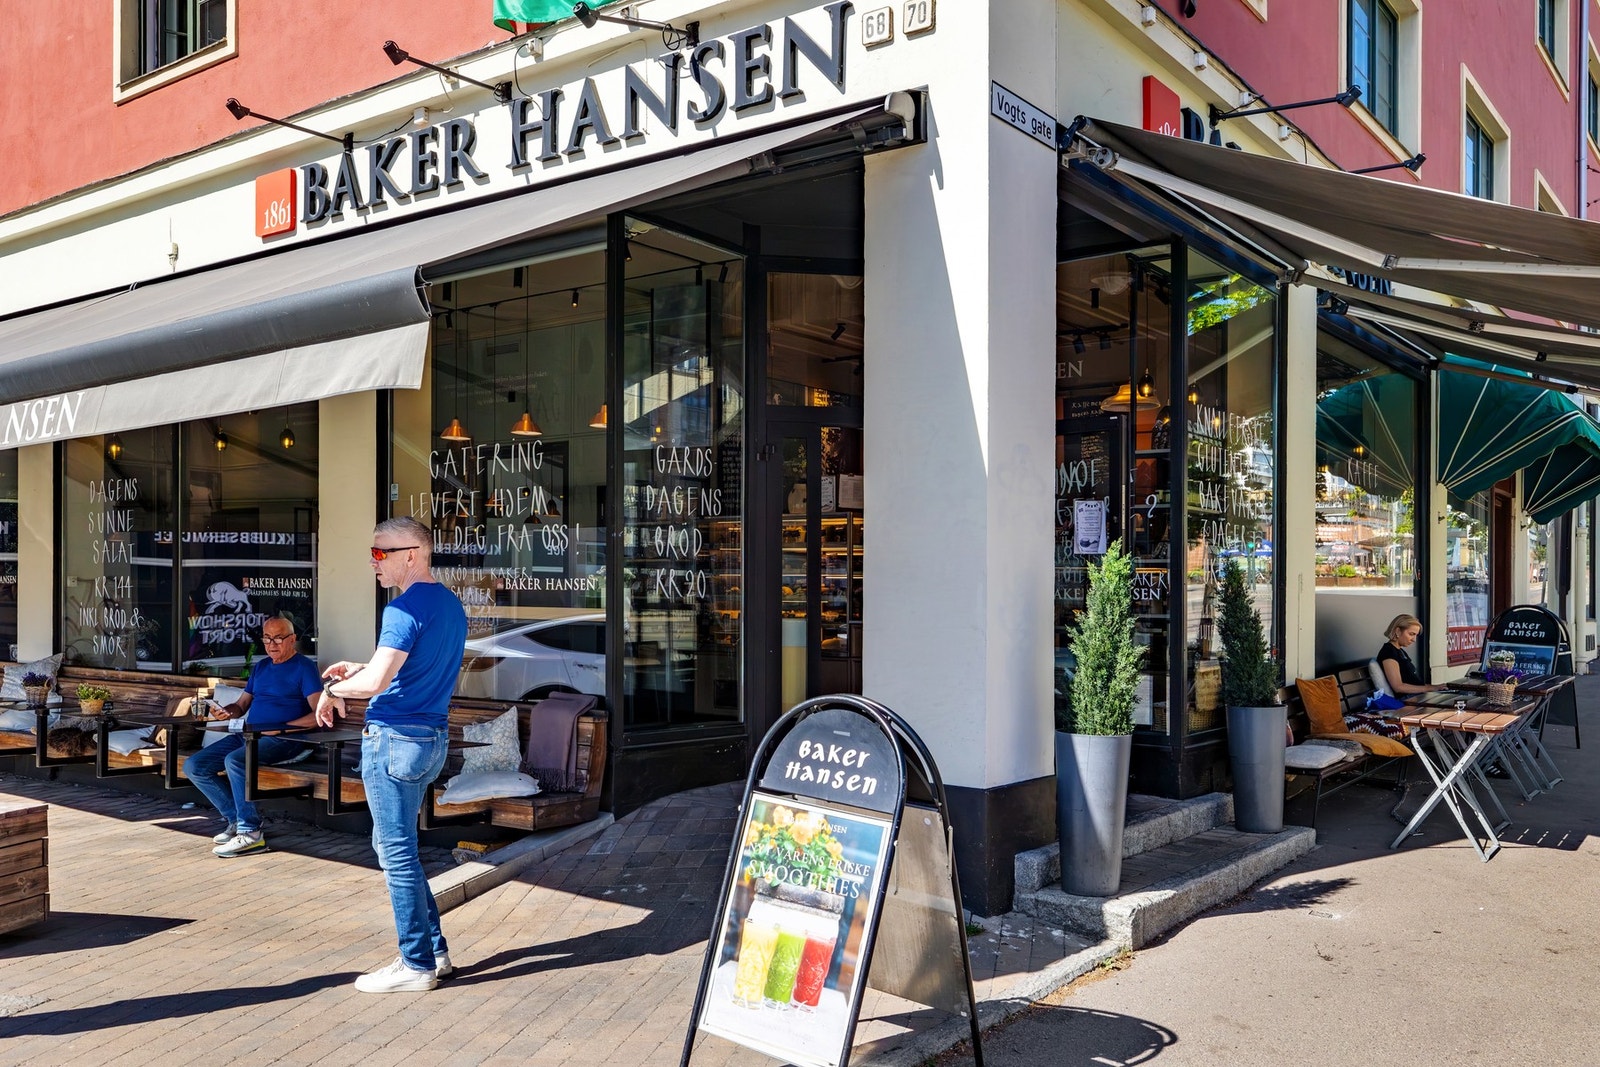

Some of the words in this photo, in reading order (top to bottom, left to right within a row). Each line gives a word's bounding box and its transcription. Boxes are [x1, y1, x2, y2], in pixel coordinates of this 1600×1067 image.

[866, 12, 885, 38] 68
[907, 1, 927, 28] 70
[301, 121, 488, 223] BAKER
[506, 1, 852, 169] HANSEN
[997, 92, 1026, 123] Vogts
[1031, 117, 1052, 140] gate
[264, 199, 291, 229] 1861
[2, 391, 85, 444] NSEN
[89, 478, 137, 504] DAGENS
[410, 489, 480, 518] LEVERT
[494, 486, 548, 518] HJEM
[646, 485, 722, 516] DAGENS
[88, 509, 134, 534] SUNNE
[455, 524, 486, 551] DEG
[497, 523, 532, 552] FRA
[541, 524, 569, 550] OSS
[93, 540, 135, 565] SALAT
[95, 575, 110, 599] KR
[114, 575, 134, 599] 144
[249, 577, 275, 588] BAKER
[277, 578, 312, 589] HANSEN
[505, 577, 541, 590] BAKER
[546, 577, 596, 591] HANSEN
[656, 568, 683, 599] KR
[685, 569, 706, 599] 20
[130, 607, 144, 628] &
